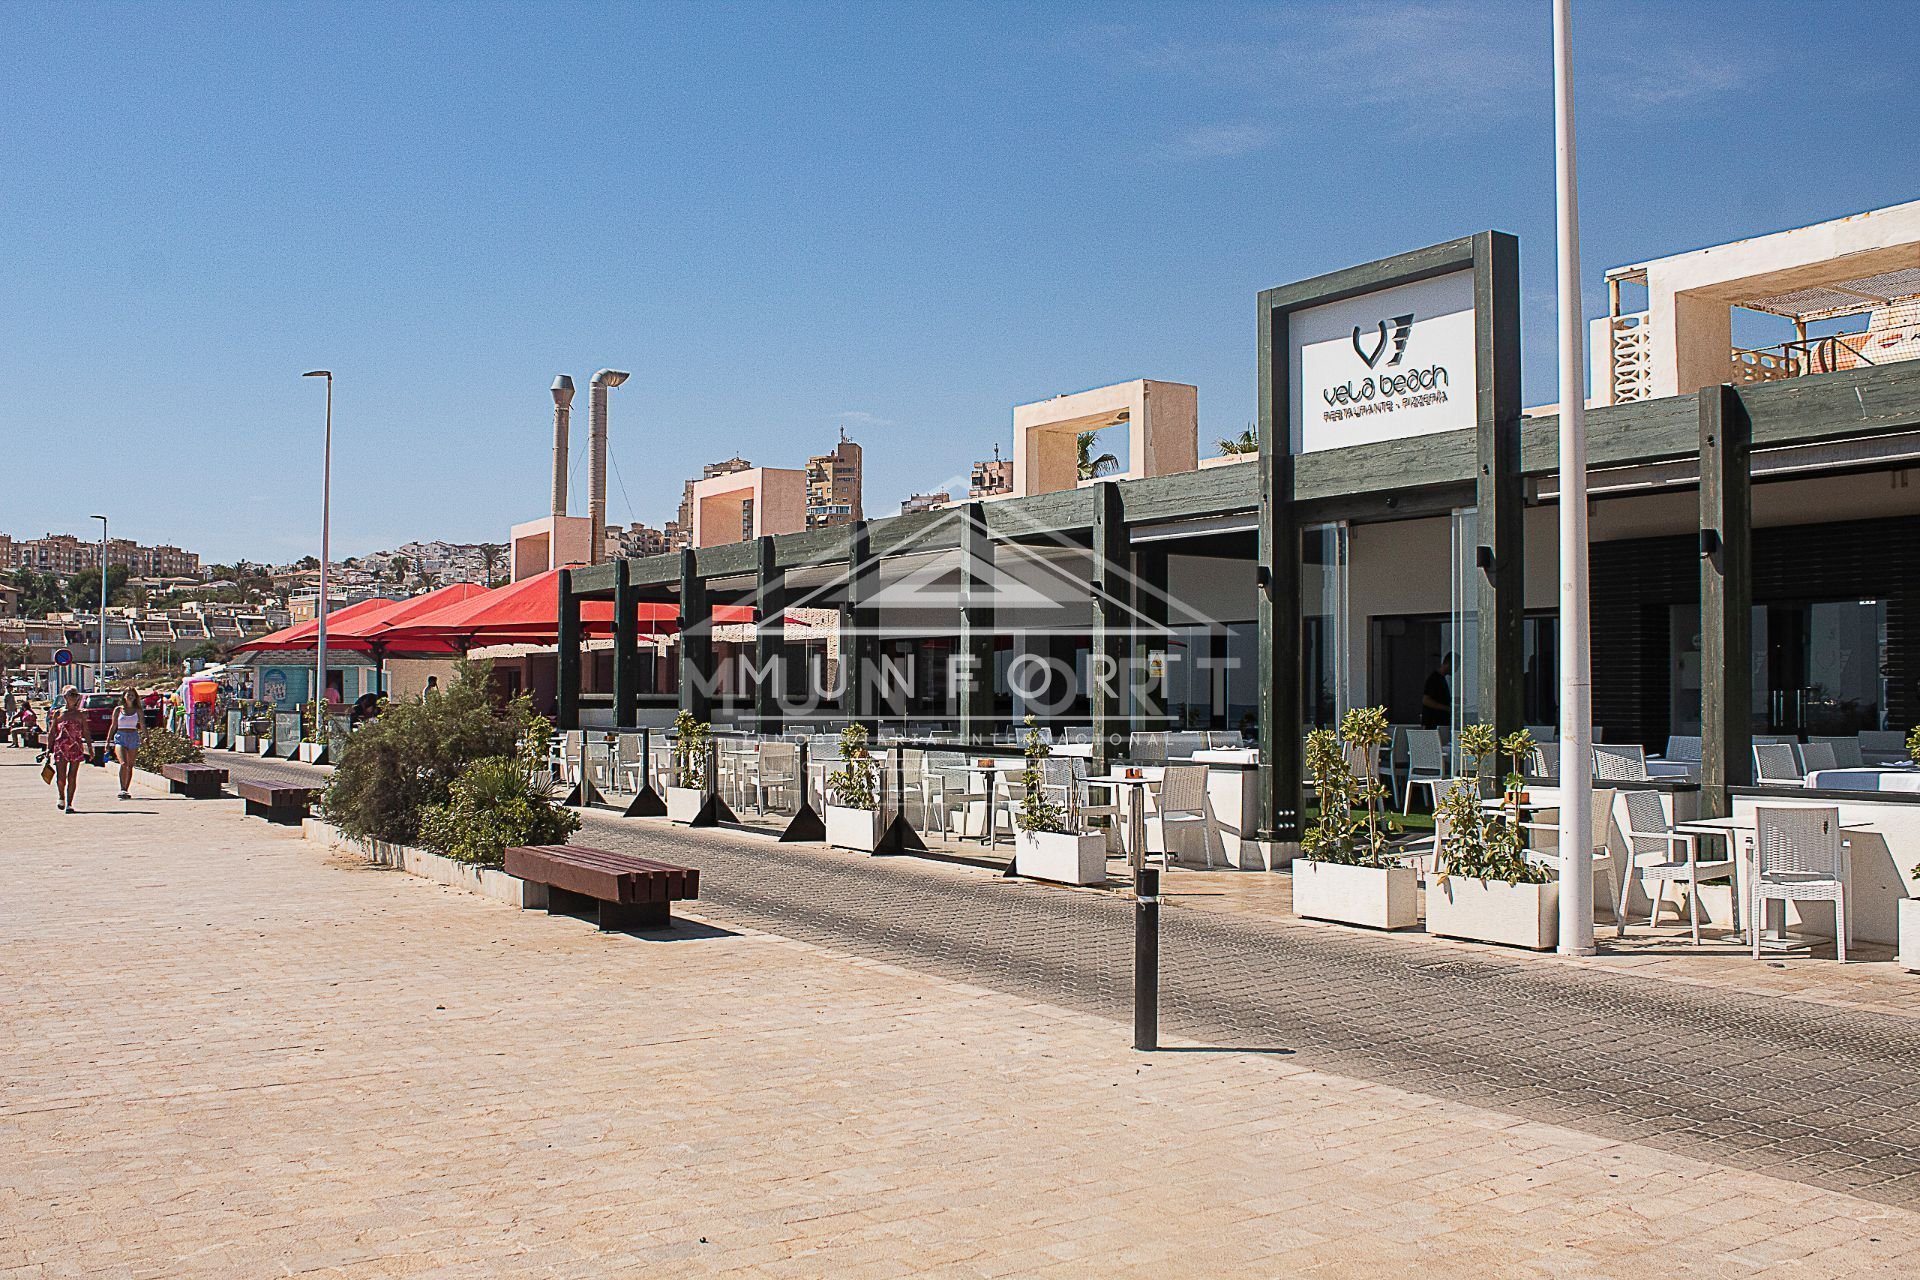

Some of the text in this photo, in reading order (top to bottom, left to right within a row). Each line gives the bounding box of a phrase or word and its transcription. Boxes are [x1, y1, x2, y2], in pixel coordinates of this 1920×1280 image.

[1379, 365, 1449, 398] beach
[1323, 390, 1448, 423] RESTAURANTE PIZZERIA
